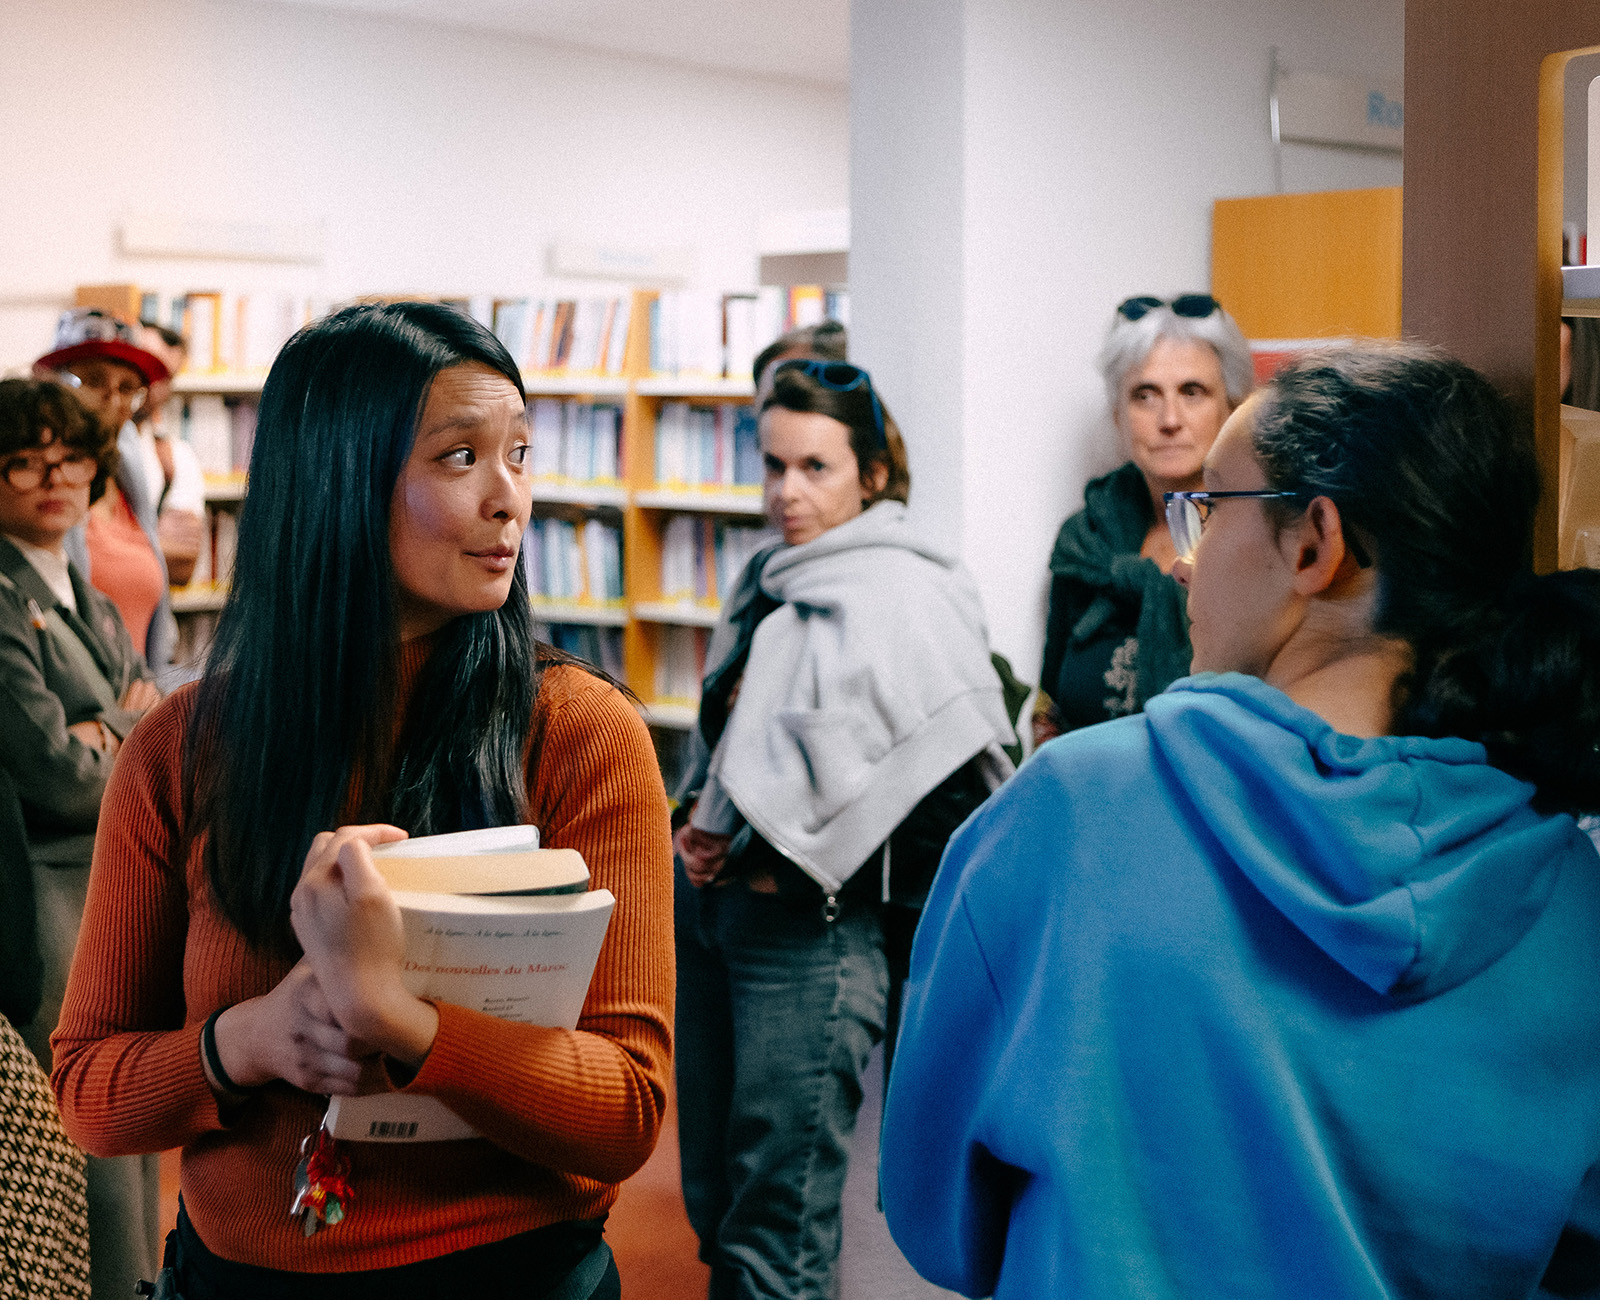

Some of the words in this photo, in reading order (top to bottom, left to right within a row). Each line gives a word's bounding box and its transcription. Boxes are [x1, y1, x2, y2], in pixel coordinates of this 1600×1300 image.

[404, 961, 431, 973] Des
[435, 964, 500, 976] nouvelles
[504, 964, 522, 975] du
[526, 962, 569, 974] Maroc
